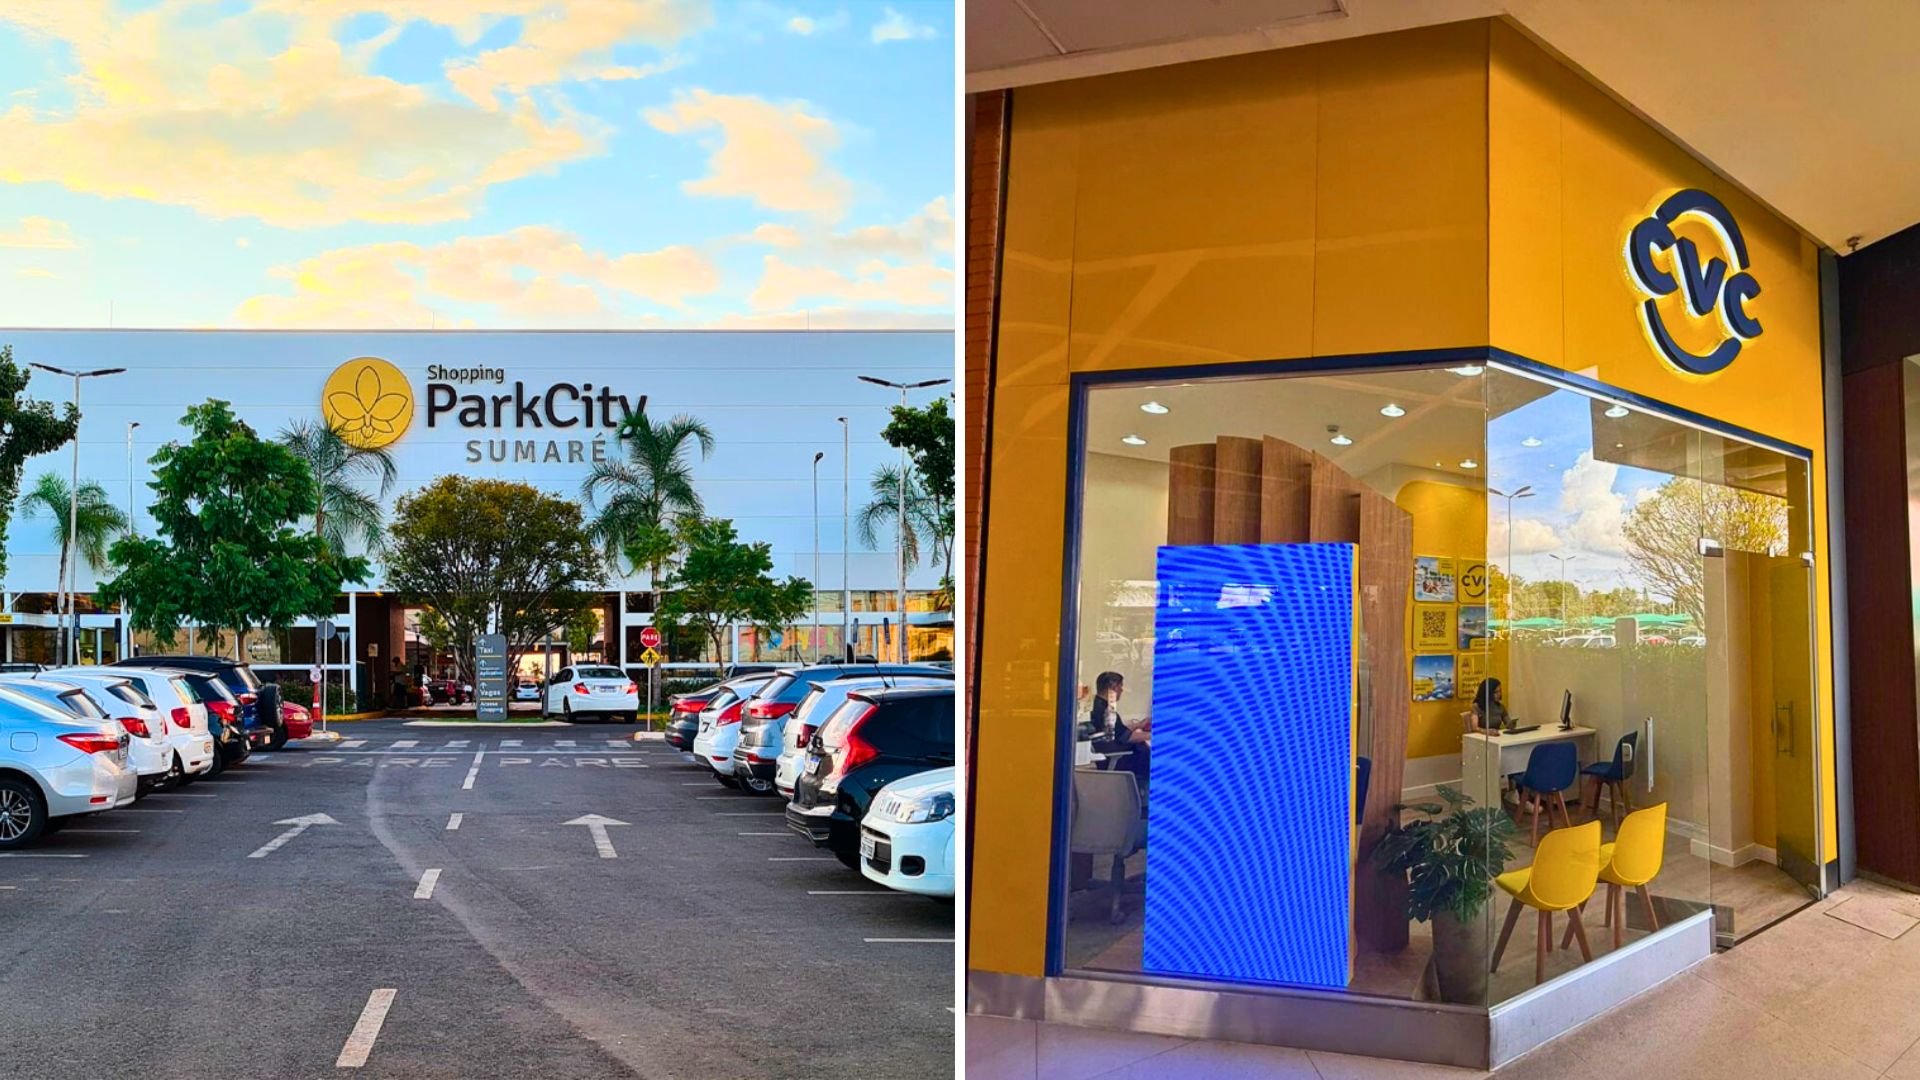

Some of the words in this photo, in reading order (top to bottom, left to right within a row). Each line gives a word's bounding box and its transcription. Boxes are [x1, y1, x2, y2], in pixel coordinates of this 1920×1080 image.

[1630, 217, 1763, 340] CVC
[427, 364, 505, 384] Shopping
[427, 381, 647, 439] ParkCity
[466, 433, 607, 463] SUMARÉ
[480, 689, 501, 697] Vagas
[302, 757, 457, 768] PARE
[499, 757, 650, 768] PARE
